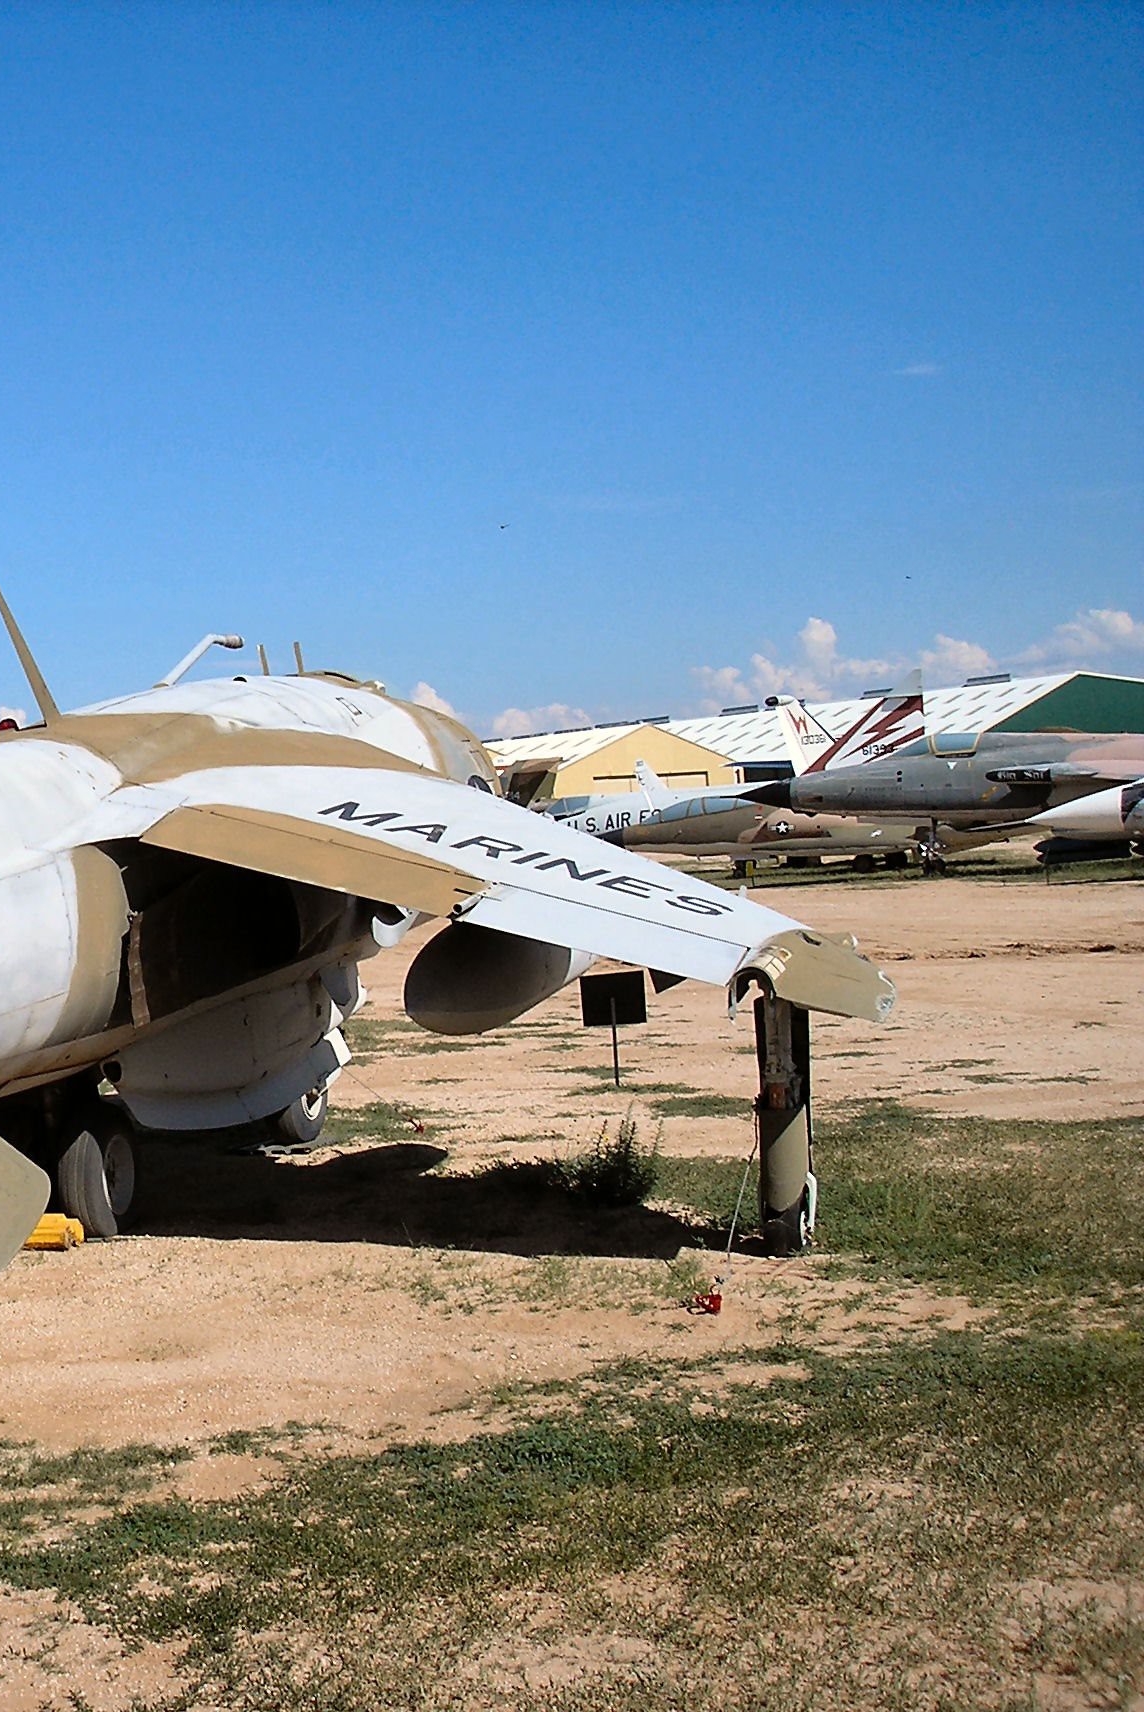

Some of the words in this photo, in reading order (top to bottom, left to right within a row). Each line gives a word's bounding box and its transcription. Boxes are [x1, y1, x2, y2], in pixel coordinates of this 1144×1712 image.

[567, 817, 600, 833] US.
[605, 811, 631, 830] AIR
[318, 801, 735, 916] MARINES
